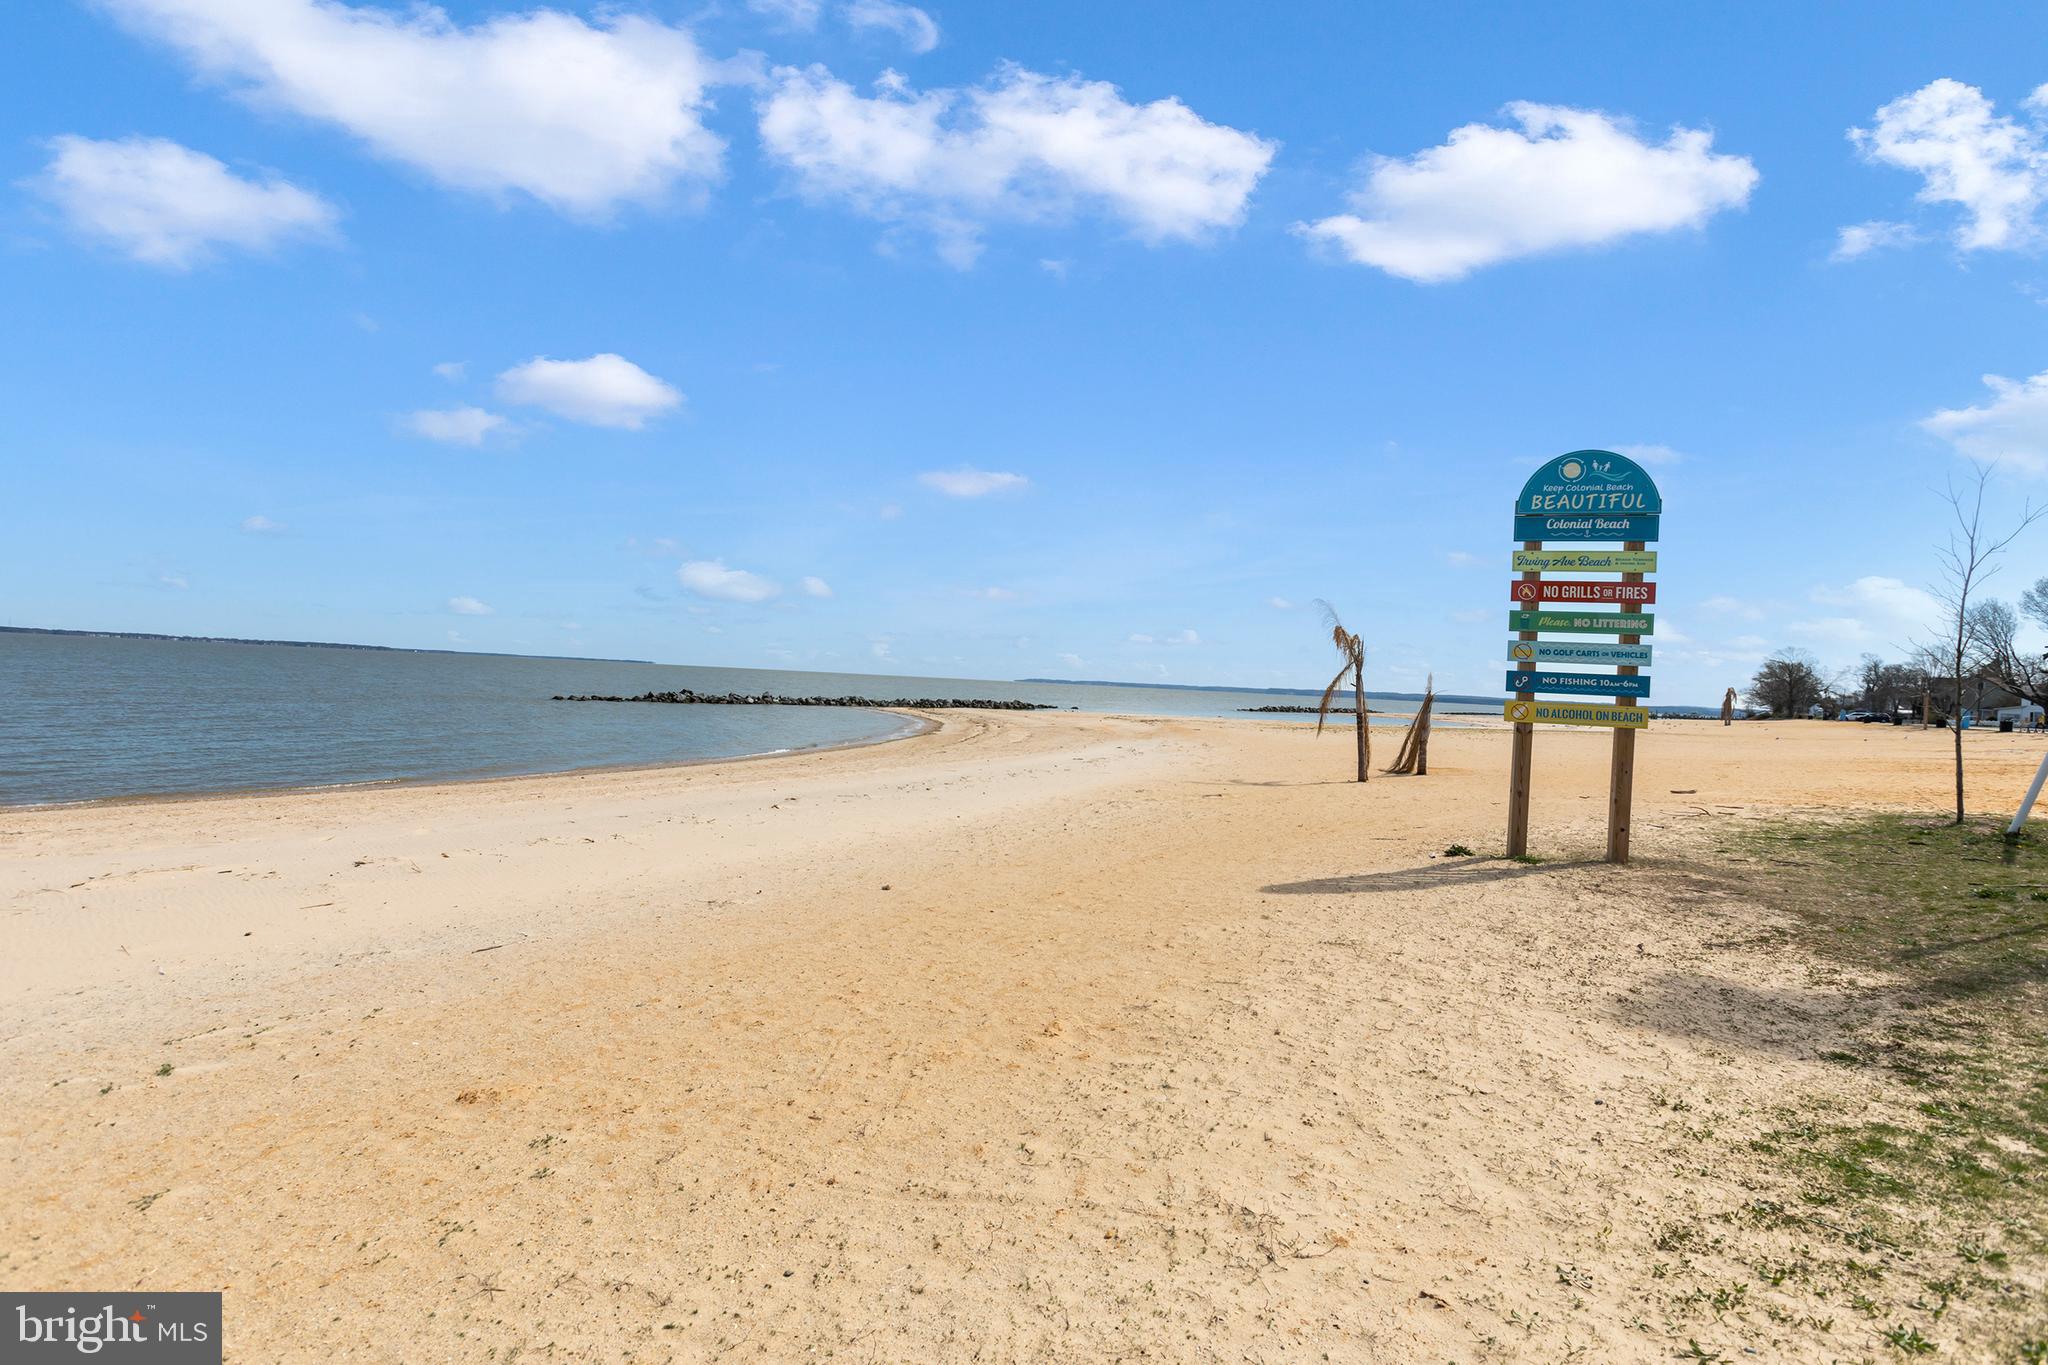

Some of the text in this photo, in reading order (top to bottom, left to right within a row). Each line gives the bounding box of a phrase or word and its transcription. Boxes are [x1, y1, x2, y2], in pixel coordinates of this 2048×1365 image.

[1543, 484, 1564, 493] Keep
[1531, 493, 1646, 510] BEAUTIFUL
[1546, 519, 1630, 529] Colonial Beach
[1516, 556, 1550, 568] Irving
[1552, 556, 1576, 566] Ave
[1578, 556, 1612, 566] Beach
[1543, 586, 1648, 599] NO GRILLS OR FIRES
[1574, 618, 1590, 627] NO
[1593, 618, 1648, 628] LITTERING
[1560, 678, 1597, 686] FISHING
[1536, 708, 1643, 722] NO ALCOHOL ON BEACH
